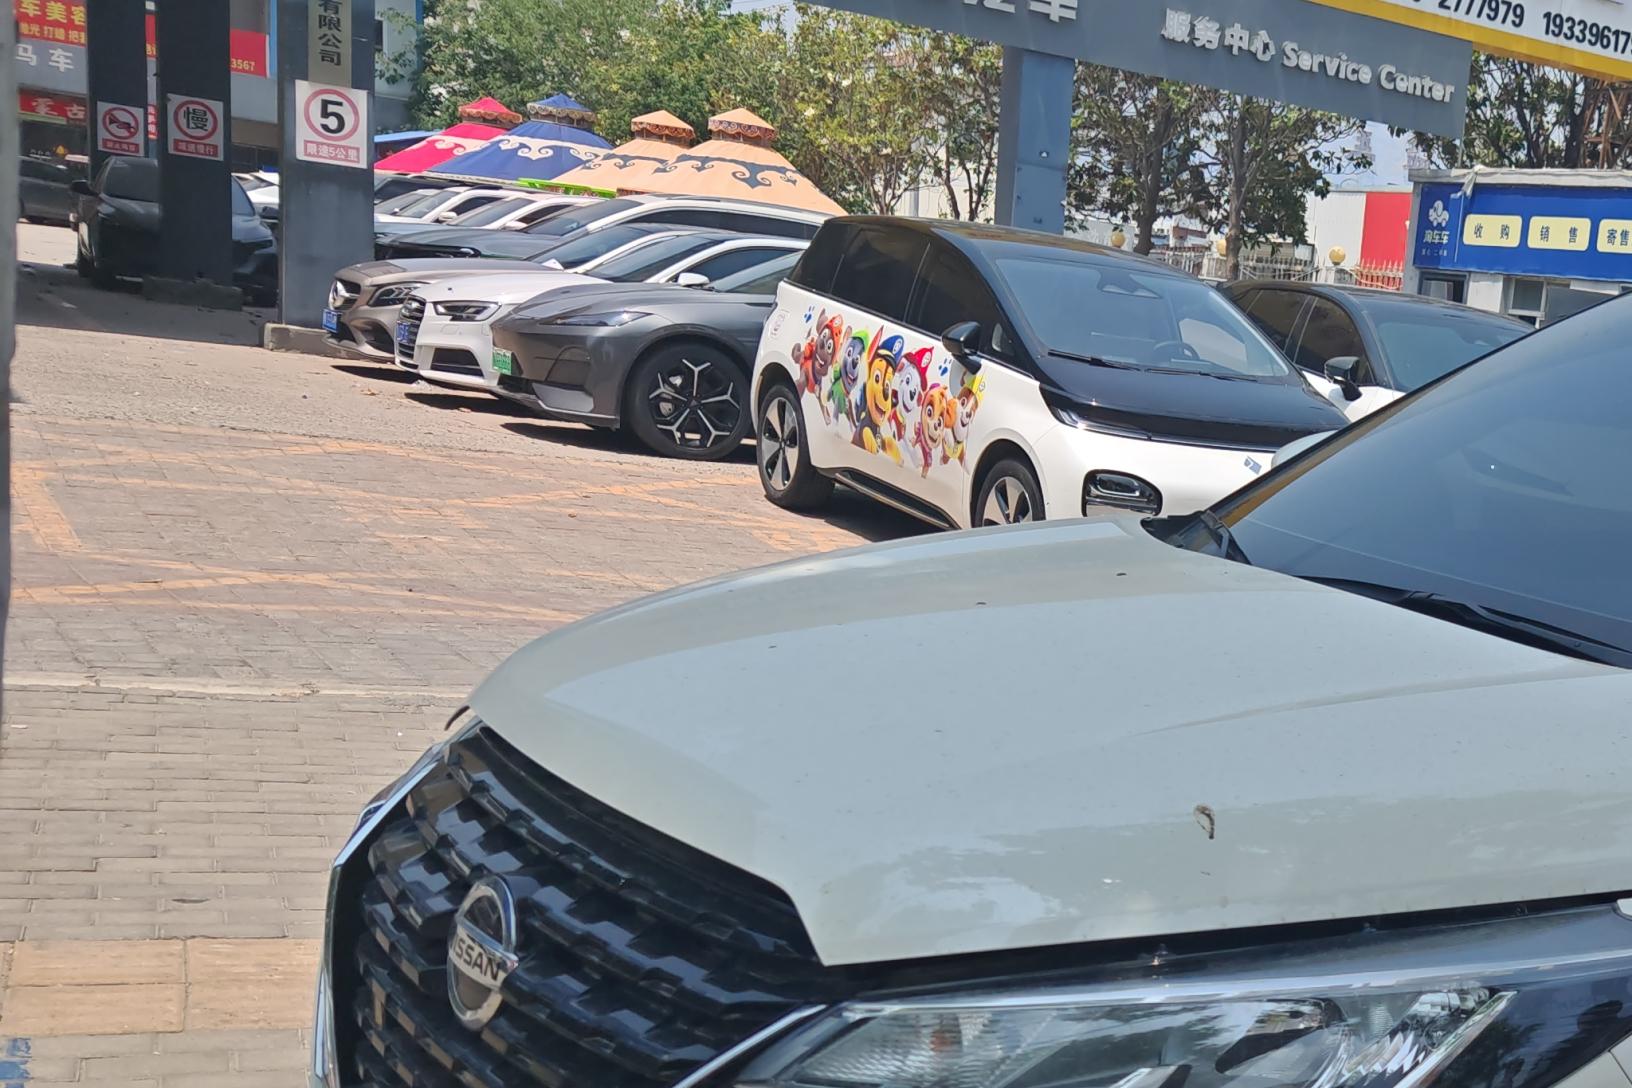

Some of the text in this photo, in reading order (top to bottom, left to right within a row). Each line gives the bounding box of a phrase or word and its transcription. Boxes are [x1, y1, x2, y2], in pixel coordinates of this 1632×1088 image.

[317, 0, 343, 66] 有限公司
[1161, 8, 1276, 62] 服务中心
[1281, 40, 1456, 103] Service Center
[183, 106, 209, 132] 慢
[320, 98, 346, 135] 5
[1473, 223, 1511, 240] 收购
[1539, 225, 1579, 244] 销售
